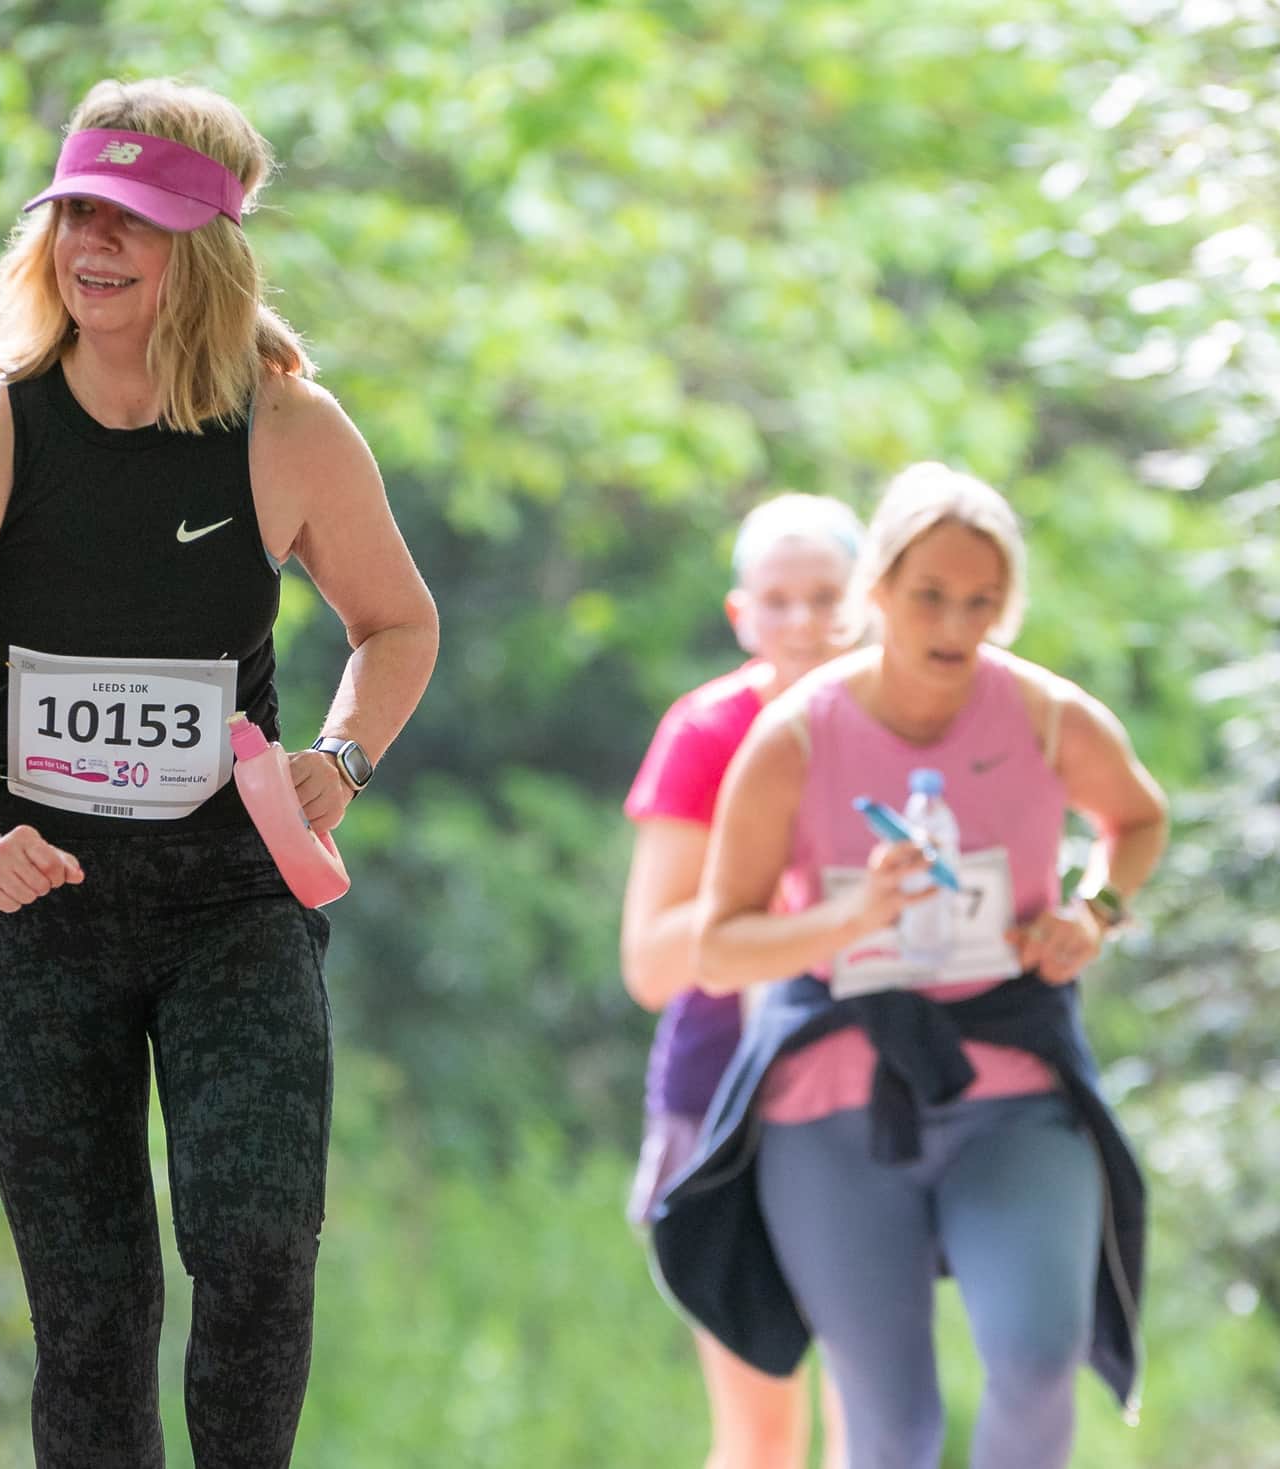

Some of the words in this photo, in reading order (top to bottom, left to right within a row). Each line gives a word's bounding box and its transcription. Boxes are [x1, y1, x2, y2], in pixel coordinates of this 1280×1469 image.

[96, 140, 143, 165] NB
[92, 682, 126, 693] LEEDS
[129, 684, 149, 694] 10K
[37, 696, 201, 748] 10153
[56, 762, 69, 771] Life
[112, 760, 149, 788] 30
[160, 775, 192, 783] Standard
[193, 775, 208, 783] Life
